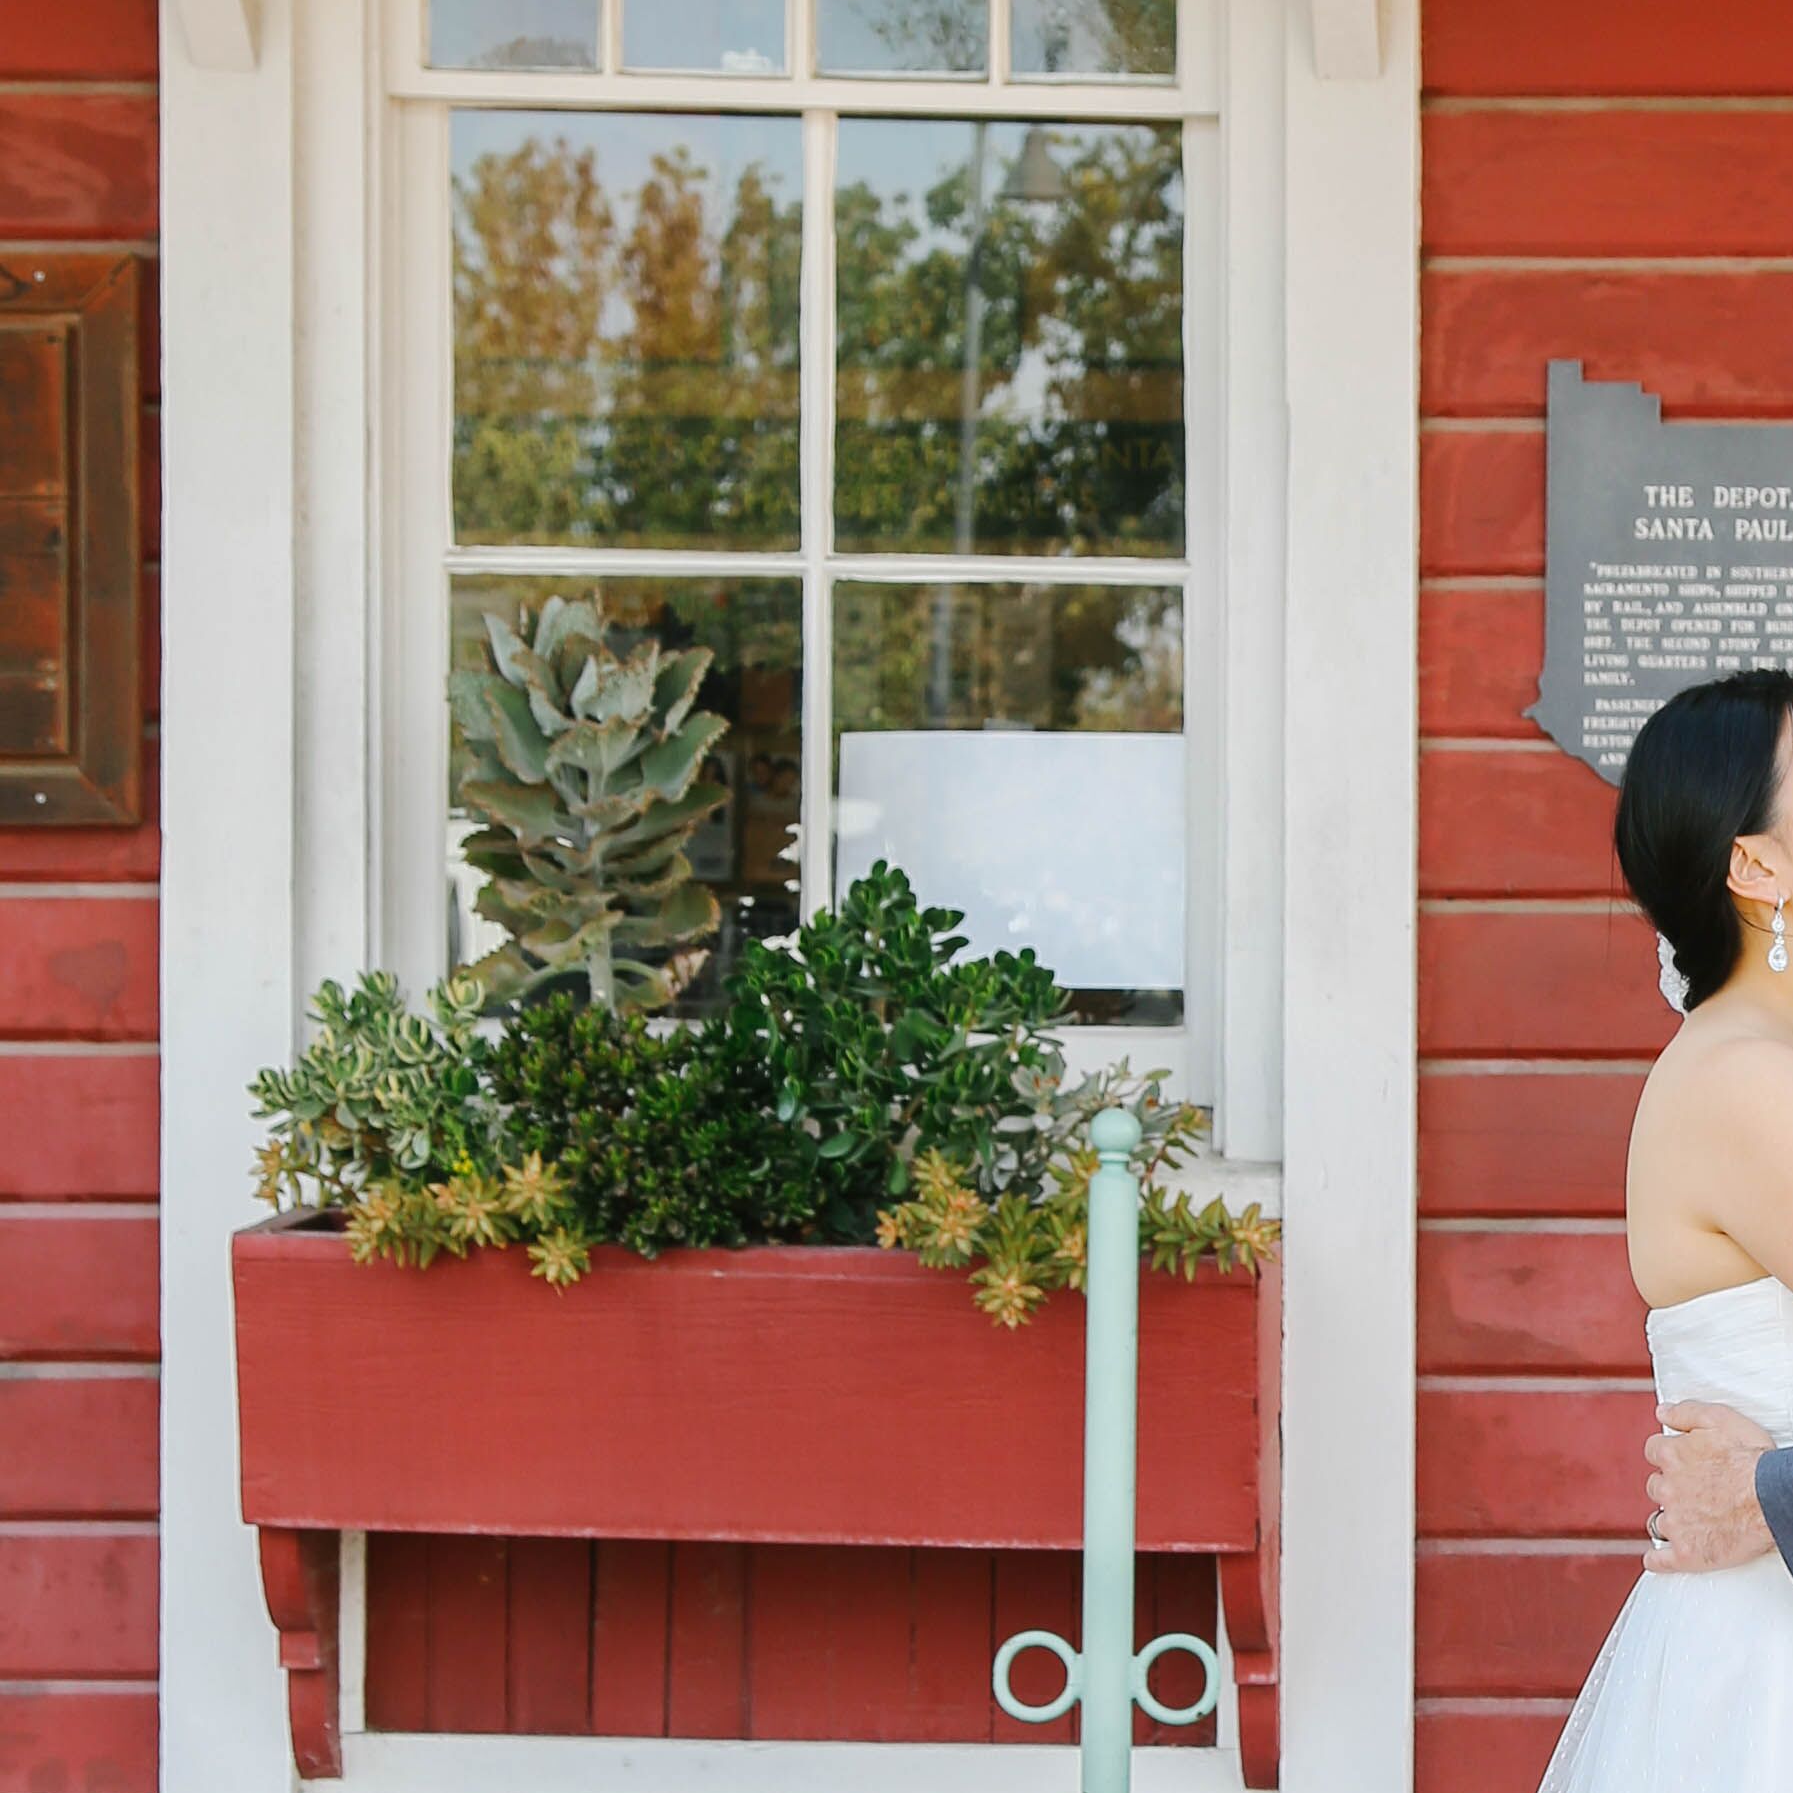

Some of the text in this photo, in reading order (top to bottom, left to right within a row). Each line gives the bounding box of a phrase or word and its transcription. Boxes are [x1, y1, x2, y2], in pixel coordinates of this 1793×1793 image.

[1643, 485, 1694, 508] THE
[1634, 517, 1714, 541] SANTA
[1705, 565, 1722, 580] IN
[1583, 582, 1670, 597] SACRAMENTO
[1583, 600, 1603, 614] BY
[1654, 601, 1684, 616] AND
[1584, 617, 1611, 632] THE
[1620, 618, 1661, 633] DEPOT
[1670, 618, 1722, 634] OPENED
[1730, 619, 1756, 634] FOR
[1626, 636, 1653, 650] THE
[1661, 636, 1711, 651] SECOND
[1718, 637, 1761, 652] STORY
[1583, 653, 1630, 668] LIVING
[1637, 654, 1708, 670] QUARTERS
[1715, 655, 1740, 670] FOR
